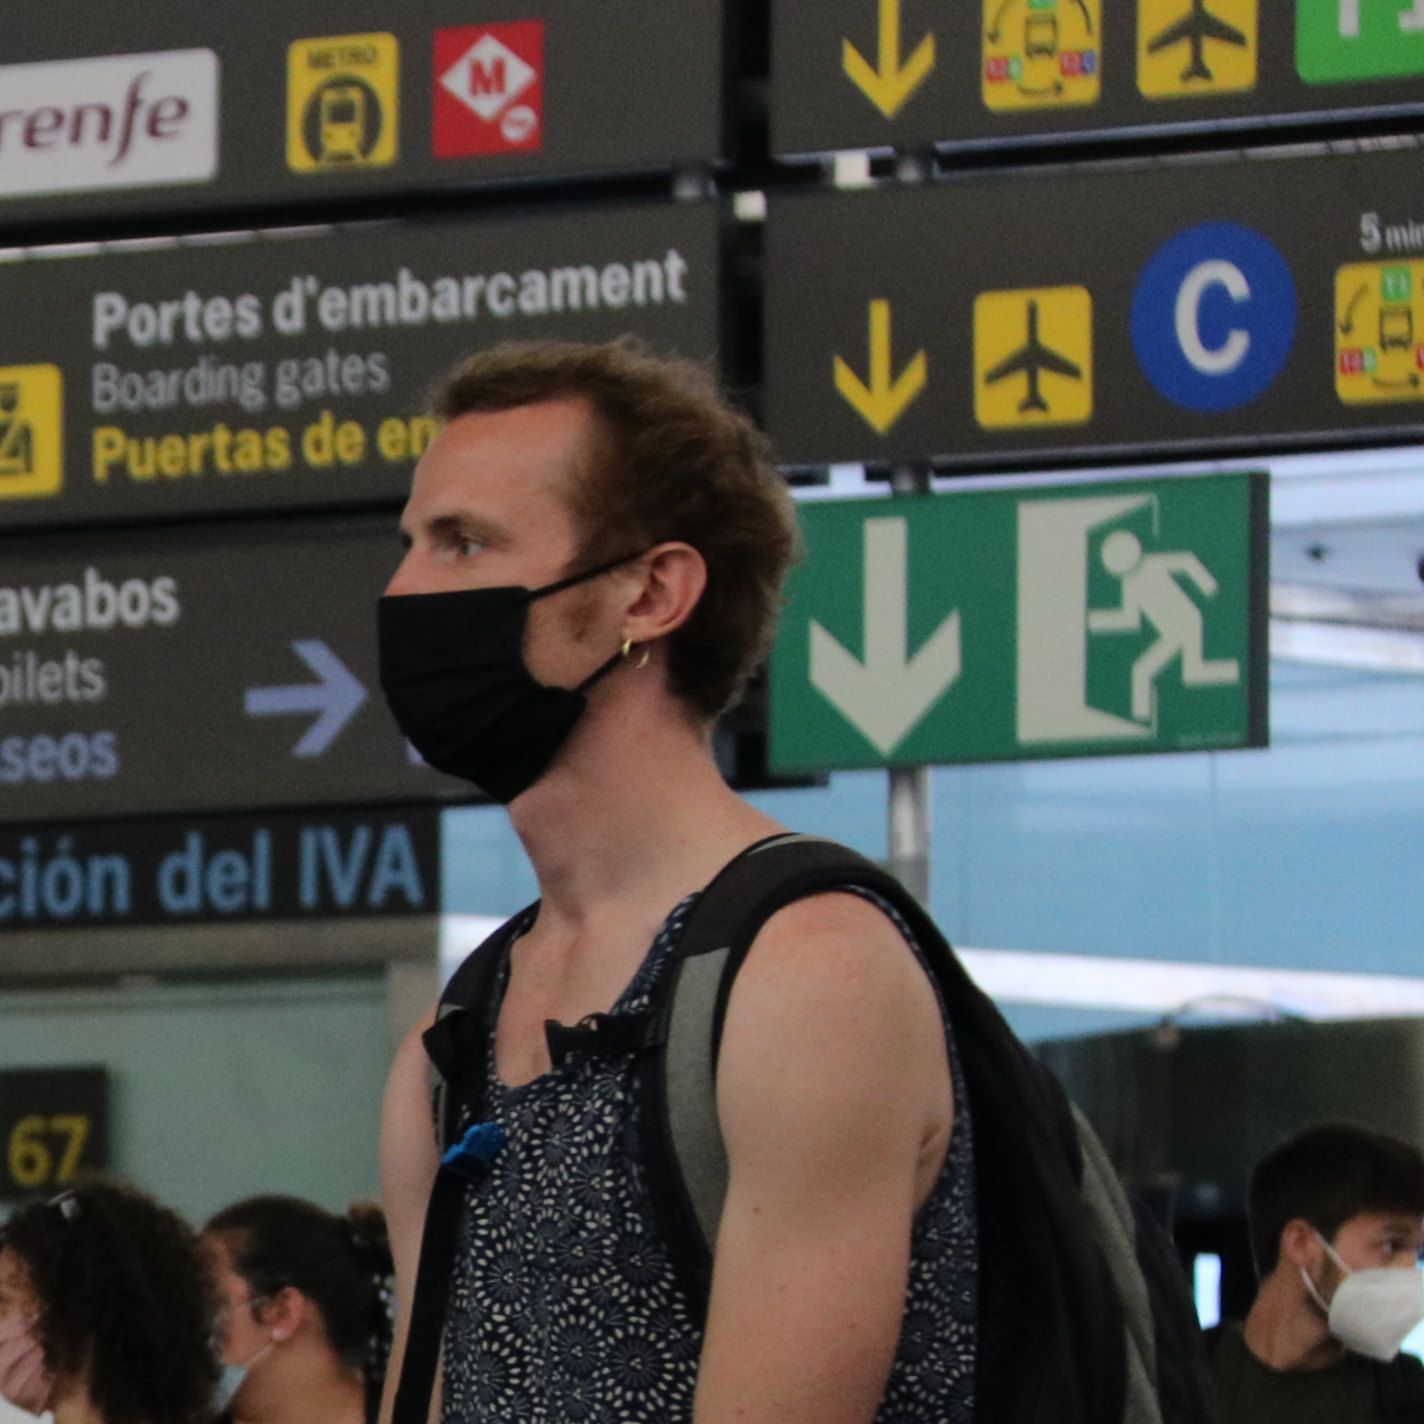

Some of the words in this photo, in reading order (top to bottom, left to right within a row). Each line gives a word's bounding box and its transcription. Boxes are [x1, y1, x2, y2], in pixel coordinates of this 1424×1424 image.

[309, 45, 376, 70] METRO
[469, 57, 507, 96] M
[1360, 211, 1382, 253] 5
[92, 292, 260, 348] Portes
[273, 249, 688, 334] d'embarcament
[1175, 258, 1251, 375] C
[93, 354, 264, 413] Boarding
[275, 350, 391, 413] gates
[93, 421, 290, 483] Puertas
[303, 410, 364, 464] de
[157, 828, 272, 911] del
[300, 822, 425, 908] IVA
[7, 1114, 91, 1186] 67
